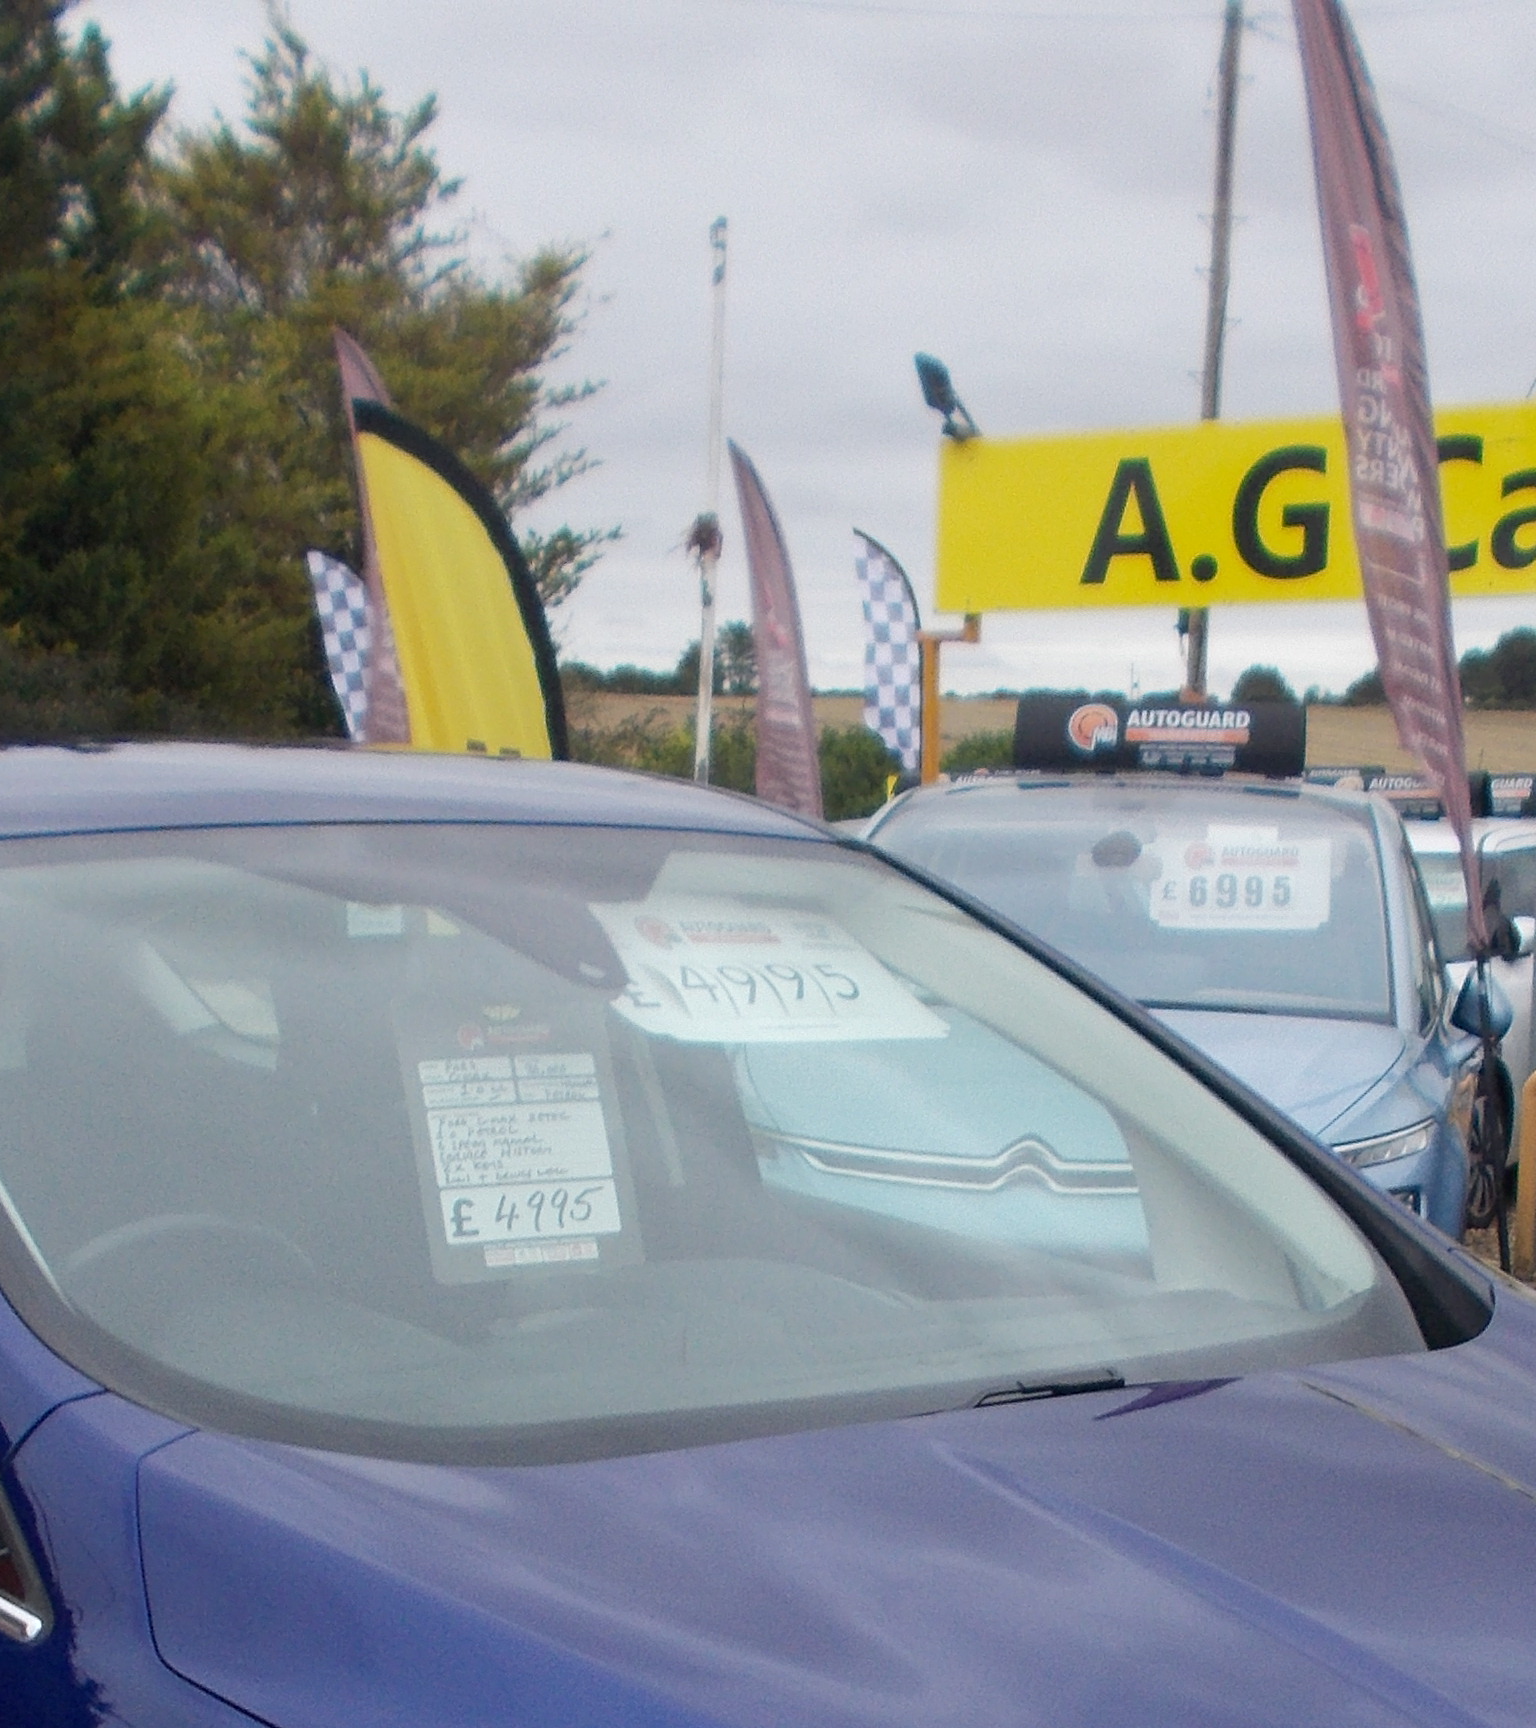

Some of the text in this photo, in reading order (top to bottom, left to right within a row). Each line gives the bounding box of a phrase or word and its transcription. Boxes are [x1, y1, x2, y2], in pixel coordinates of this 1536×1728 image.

[1080, 445, 1332, 585] A.G
[1126, 709, 1252, 729] AUTOGUARD
[494, 1185, 605, 1232] 4995
